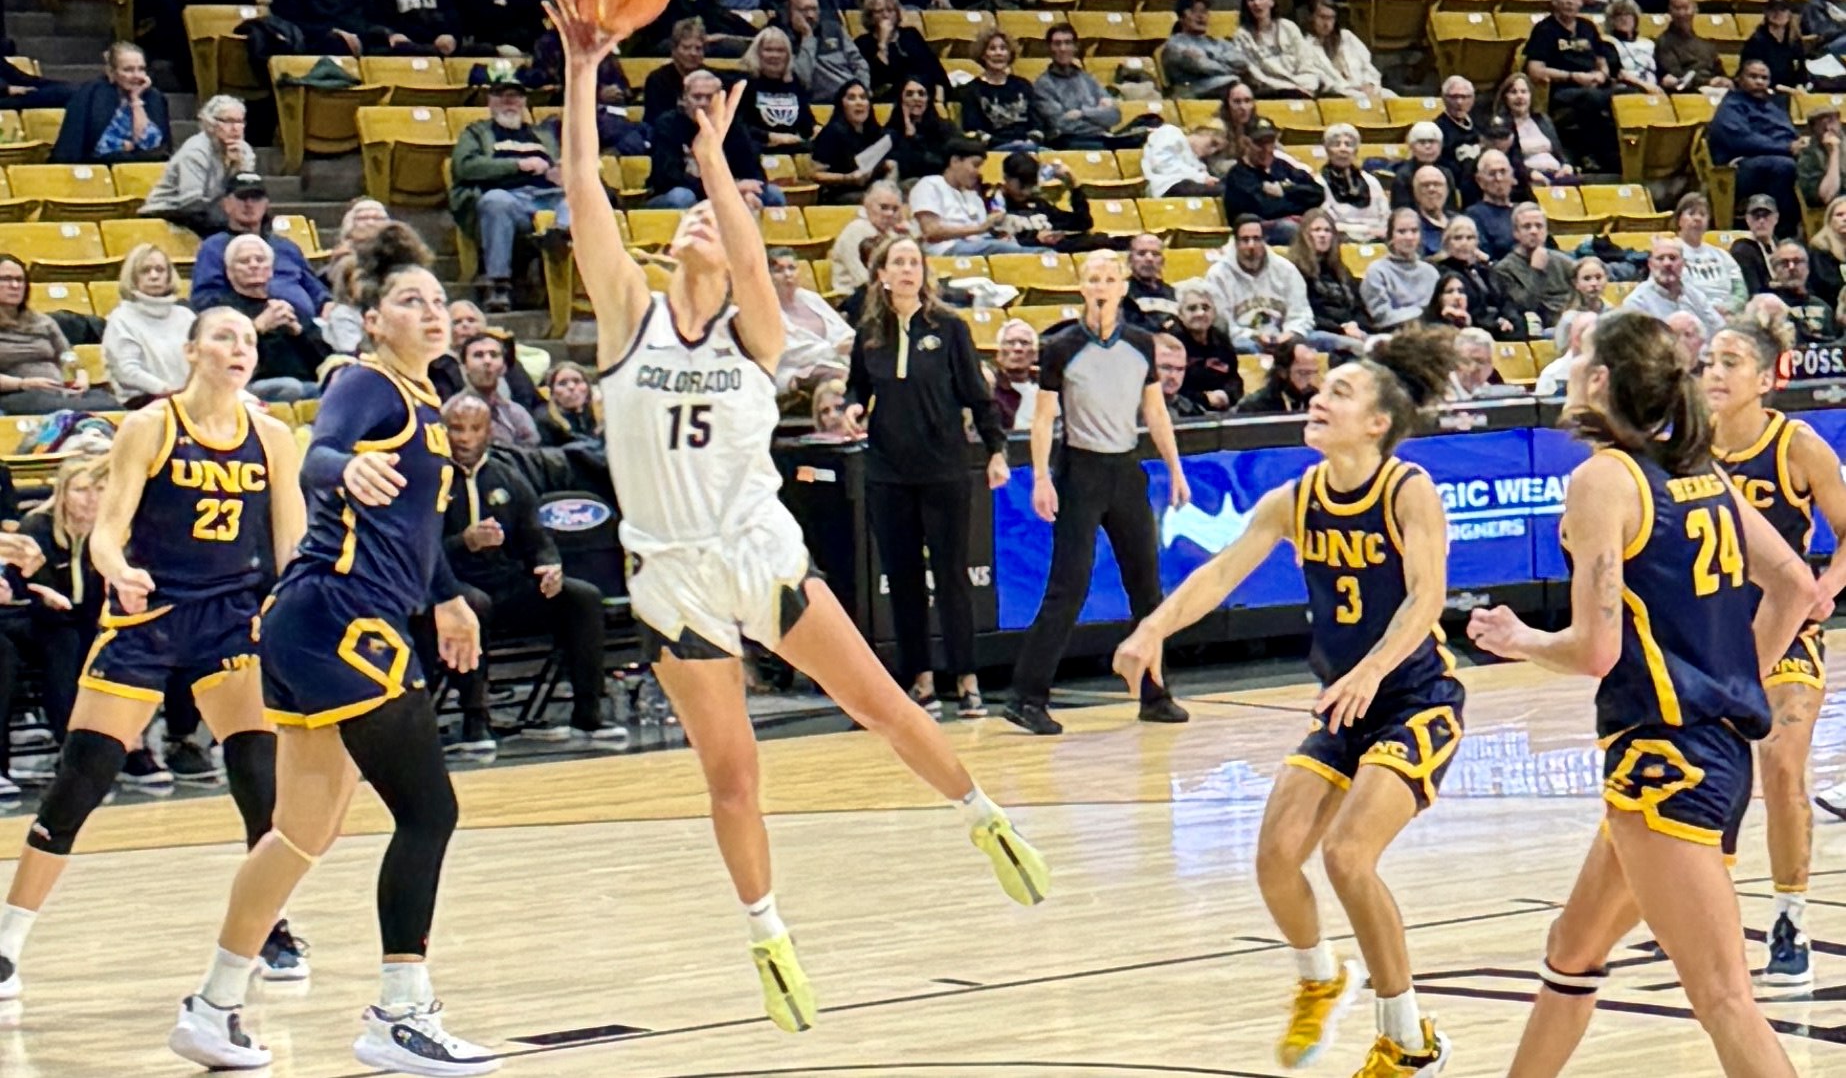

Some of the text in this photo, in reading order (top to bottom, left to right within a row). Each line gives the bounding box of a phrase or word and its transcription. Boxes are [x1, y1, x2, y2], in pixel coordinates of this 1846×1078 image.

[636, 365, 742, 394] COLORADO
[666, 404, 711, 449] 15
[171, 458, 266, 493] UNC
[1436, 480, 1489, 509] GIC
[192, 498, 244, 541] 23
[1303, 528, 1387, 569] UNC
[1685, 505, 1744, 597] 24
[1336, 575, 1363, 624] 3
